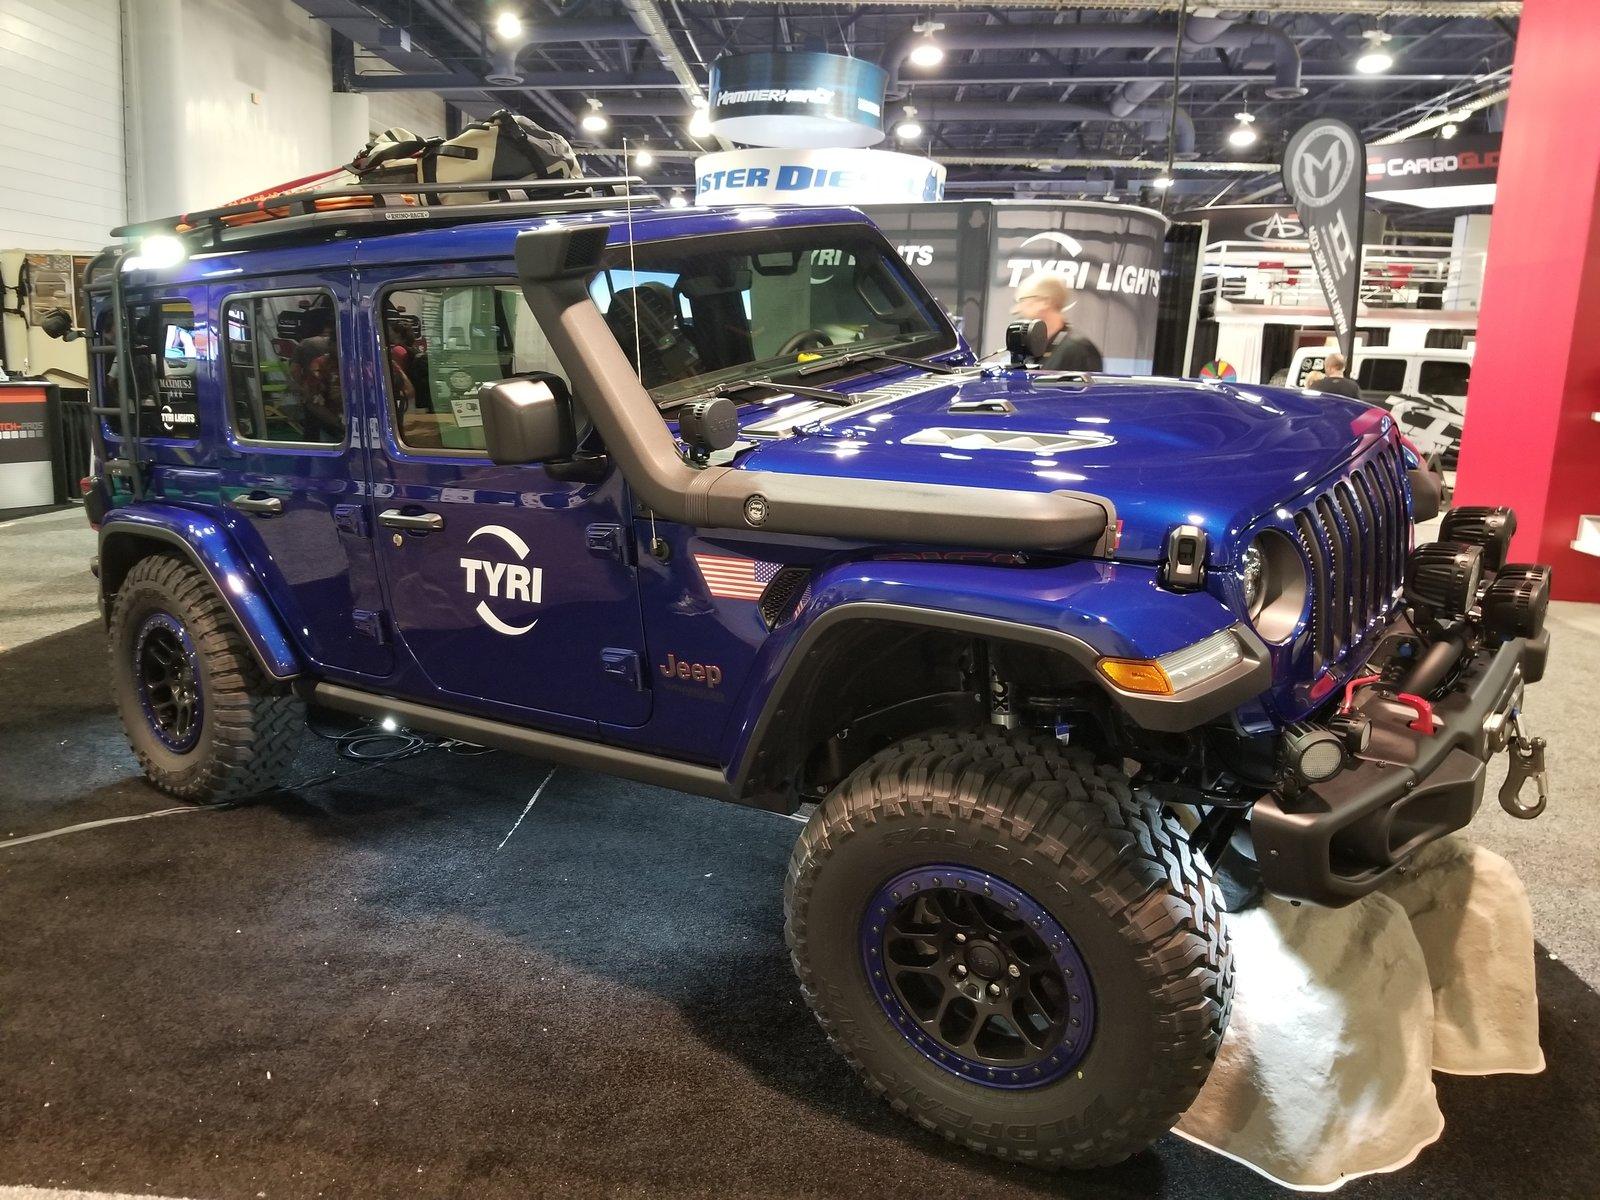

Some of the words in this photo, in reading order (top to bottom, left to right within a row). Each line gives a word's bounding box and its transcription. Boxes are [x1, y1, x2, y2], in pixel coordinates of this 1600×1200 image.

[1096, 262, 1161, 298] LIGHTS
[174, 413, 195, 424] LIGHTS
[460, 557, 543, 604] TYRI
[659, 653, 723, 689] Jeep
